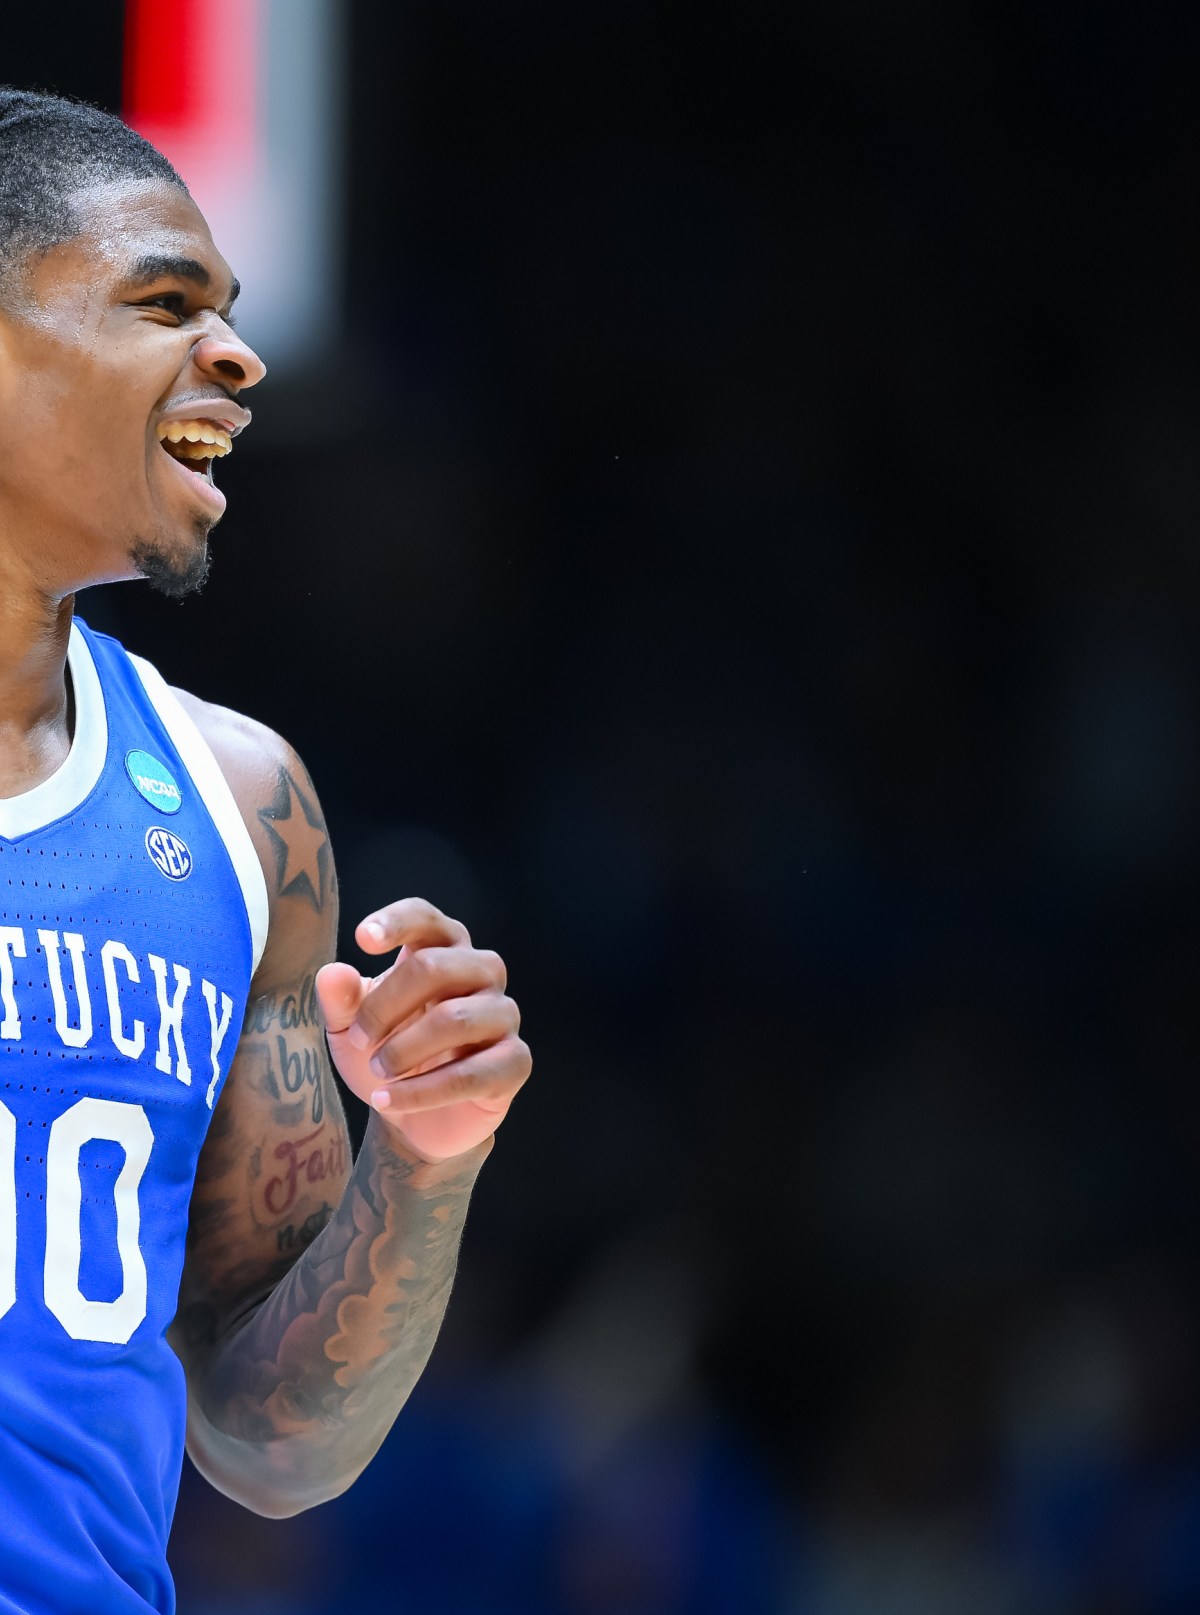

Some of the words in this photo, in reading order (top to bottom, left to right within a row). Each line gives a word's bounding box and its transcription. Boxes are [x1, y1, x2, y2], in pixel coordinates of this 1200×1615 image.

[136, 775, 182, 801] NCAA
[149, 830, 192, 877] SEC
[277, 1034, 323, 1123] by
